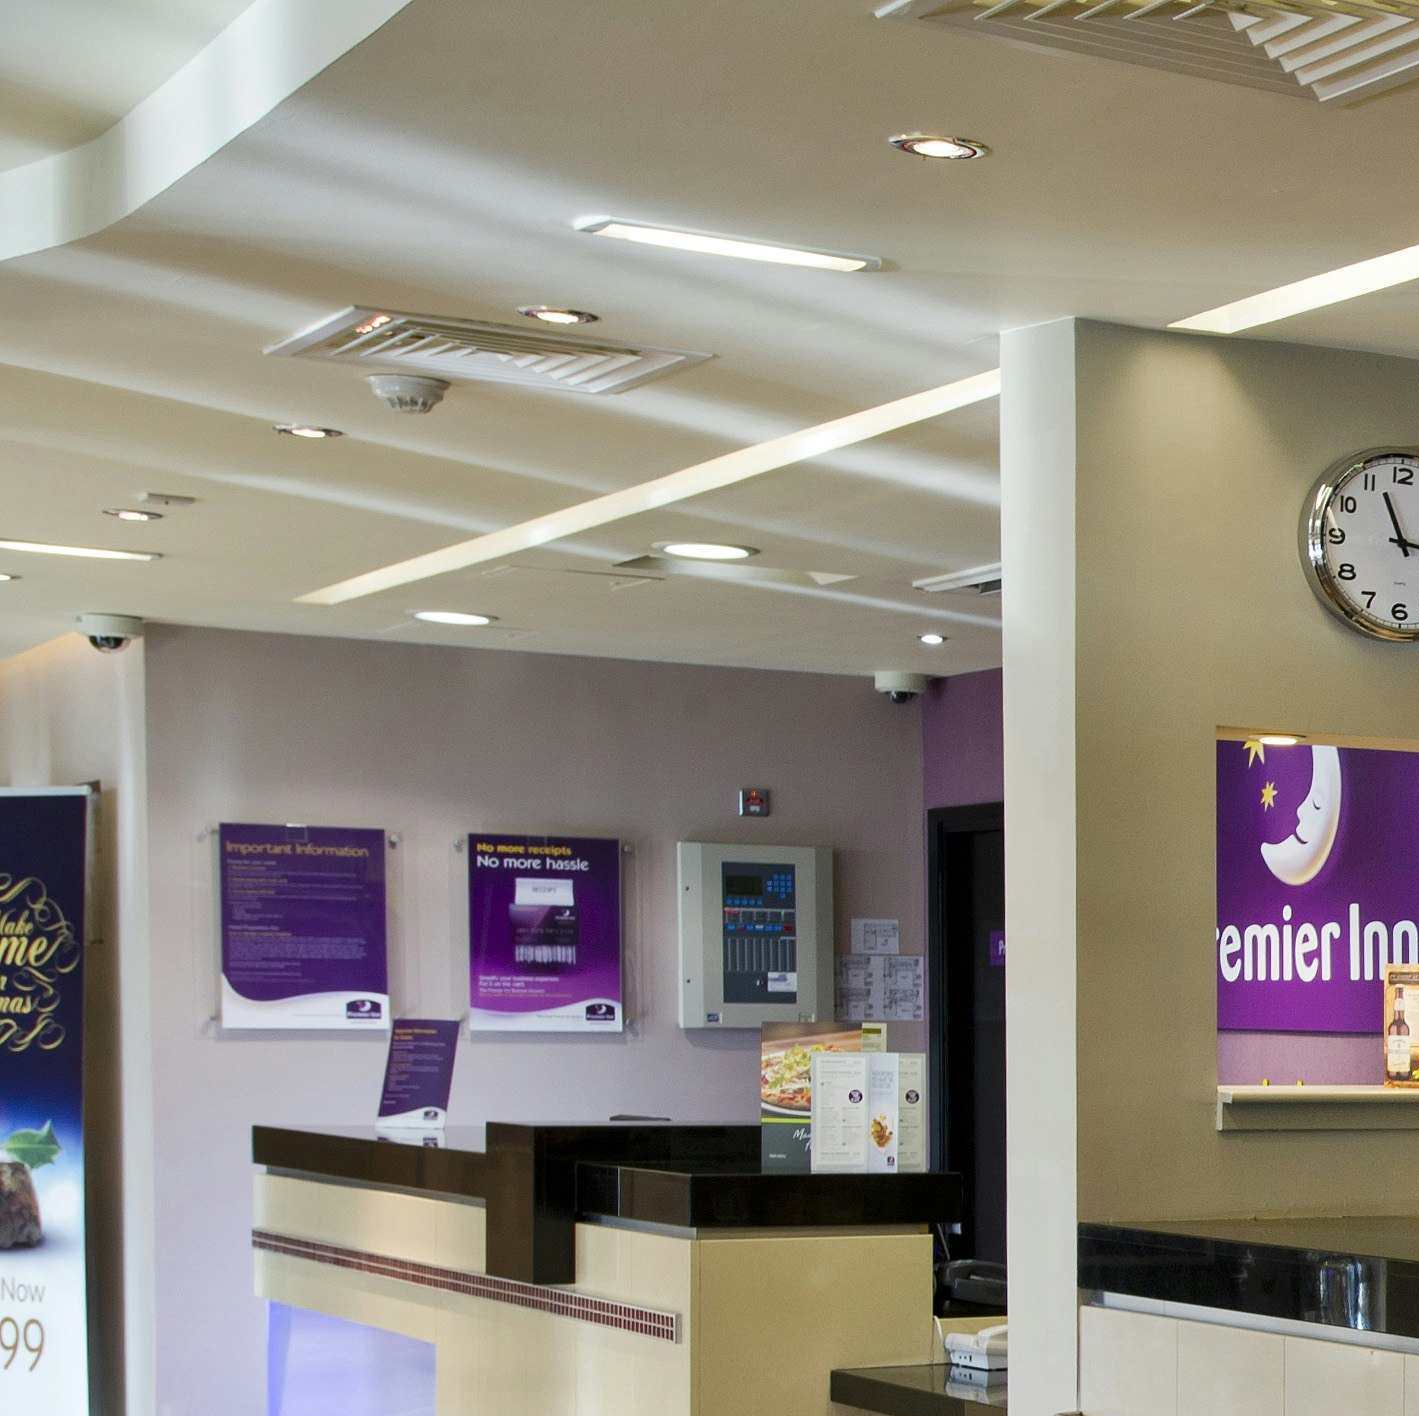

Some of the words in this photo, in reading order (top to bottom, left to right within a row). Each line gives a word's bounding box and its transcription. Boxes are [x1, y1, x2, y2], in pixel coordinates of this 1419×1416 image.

[1364, 474, 1375, 491] 11
[1393, 467, 1413, 485] 12
[1340, 496, 1356, 513] 10
[1329, 528, 1345, 544] 9
[1338, 563, 1356, 580] 8
[1361, 591, 1376, 608] 7
[1391, 603, 1408, 621] 6
[226, 842, 291, 855] Important
[295, 843, 369, 857] Information
[477, 843, 493, 852] No
[497, 845, 524, 853] more
[528, 845, 572, 856] receipts
[477, 856, 499, 867] No
[503, 858, 541, 869] more
[546, 857, 589, 871] hassle
[1216, 905, 1341, 982] emier
[1349, 903, 1418, 981] Inn
[1, 1278, 45, 1302] Now
[0, 1317, 45, 1371] 99
